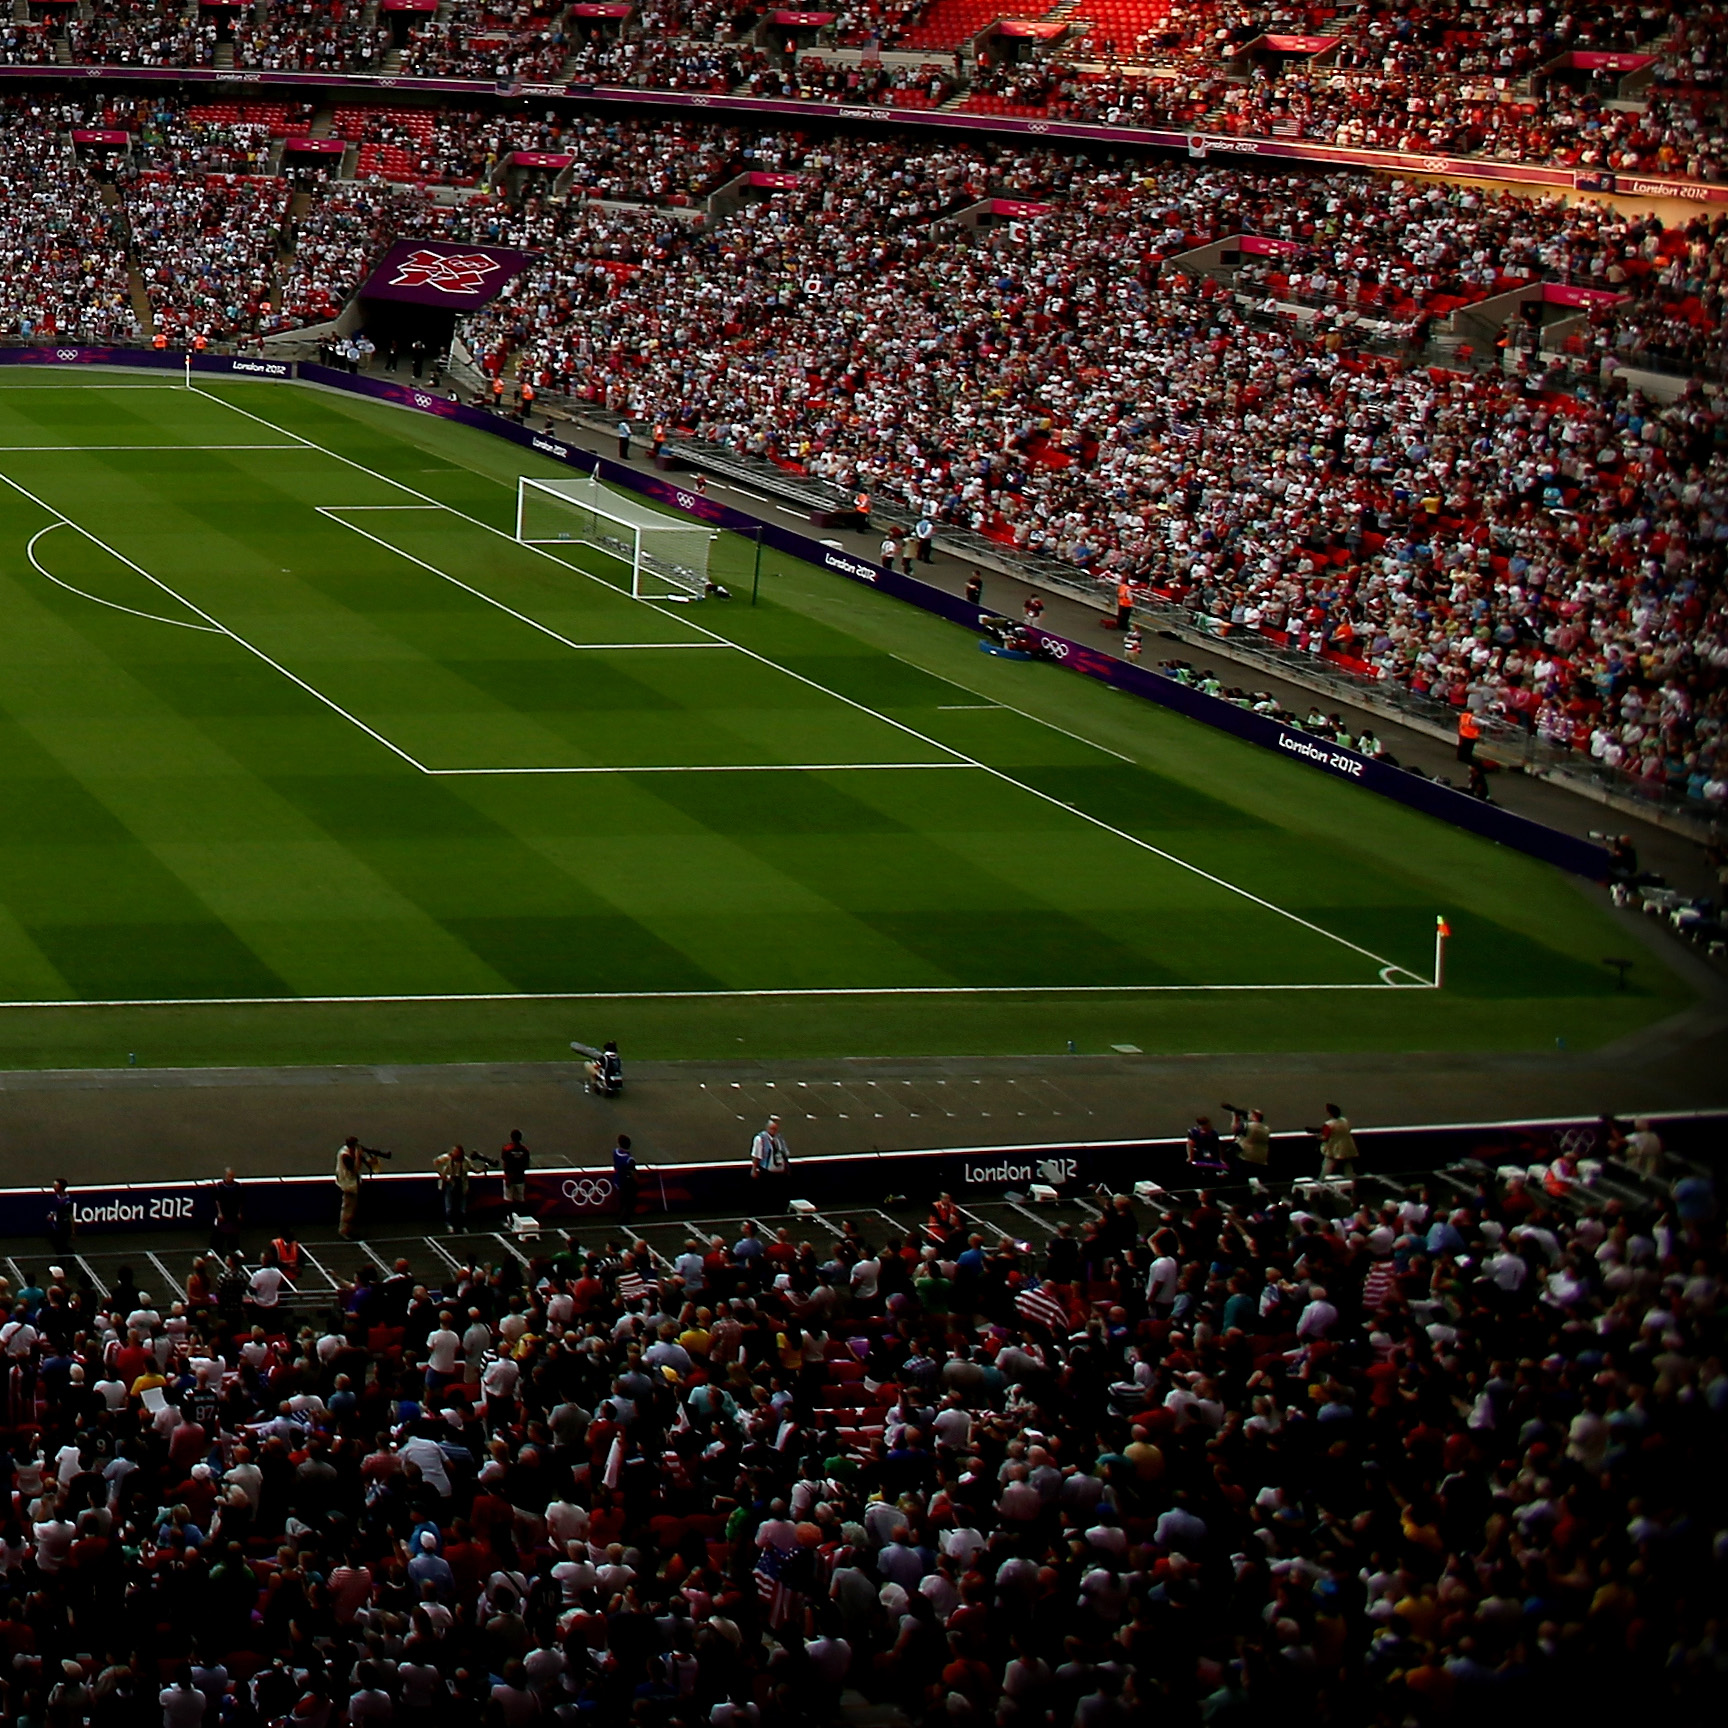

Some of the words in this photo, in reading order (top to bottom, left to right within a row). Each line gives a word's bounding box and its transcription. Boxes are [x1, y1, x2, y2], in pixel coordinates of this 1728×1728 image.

[1205, 141, 1234, 150] ondon
[1634, 181, 1679, 195] London
[1679, 186, 1708, 199] 2012
[232, 361, 264, 372] London
[825, 552, 856, 574] London
[1278, 732, 1328, 763] London
[1330, 752, 1364, 777] 2012
[964, 1160, 1031, 1183] London
[72, 1199, 144, 1223] London
[148, 1197, 194, 1219] 2012
